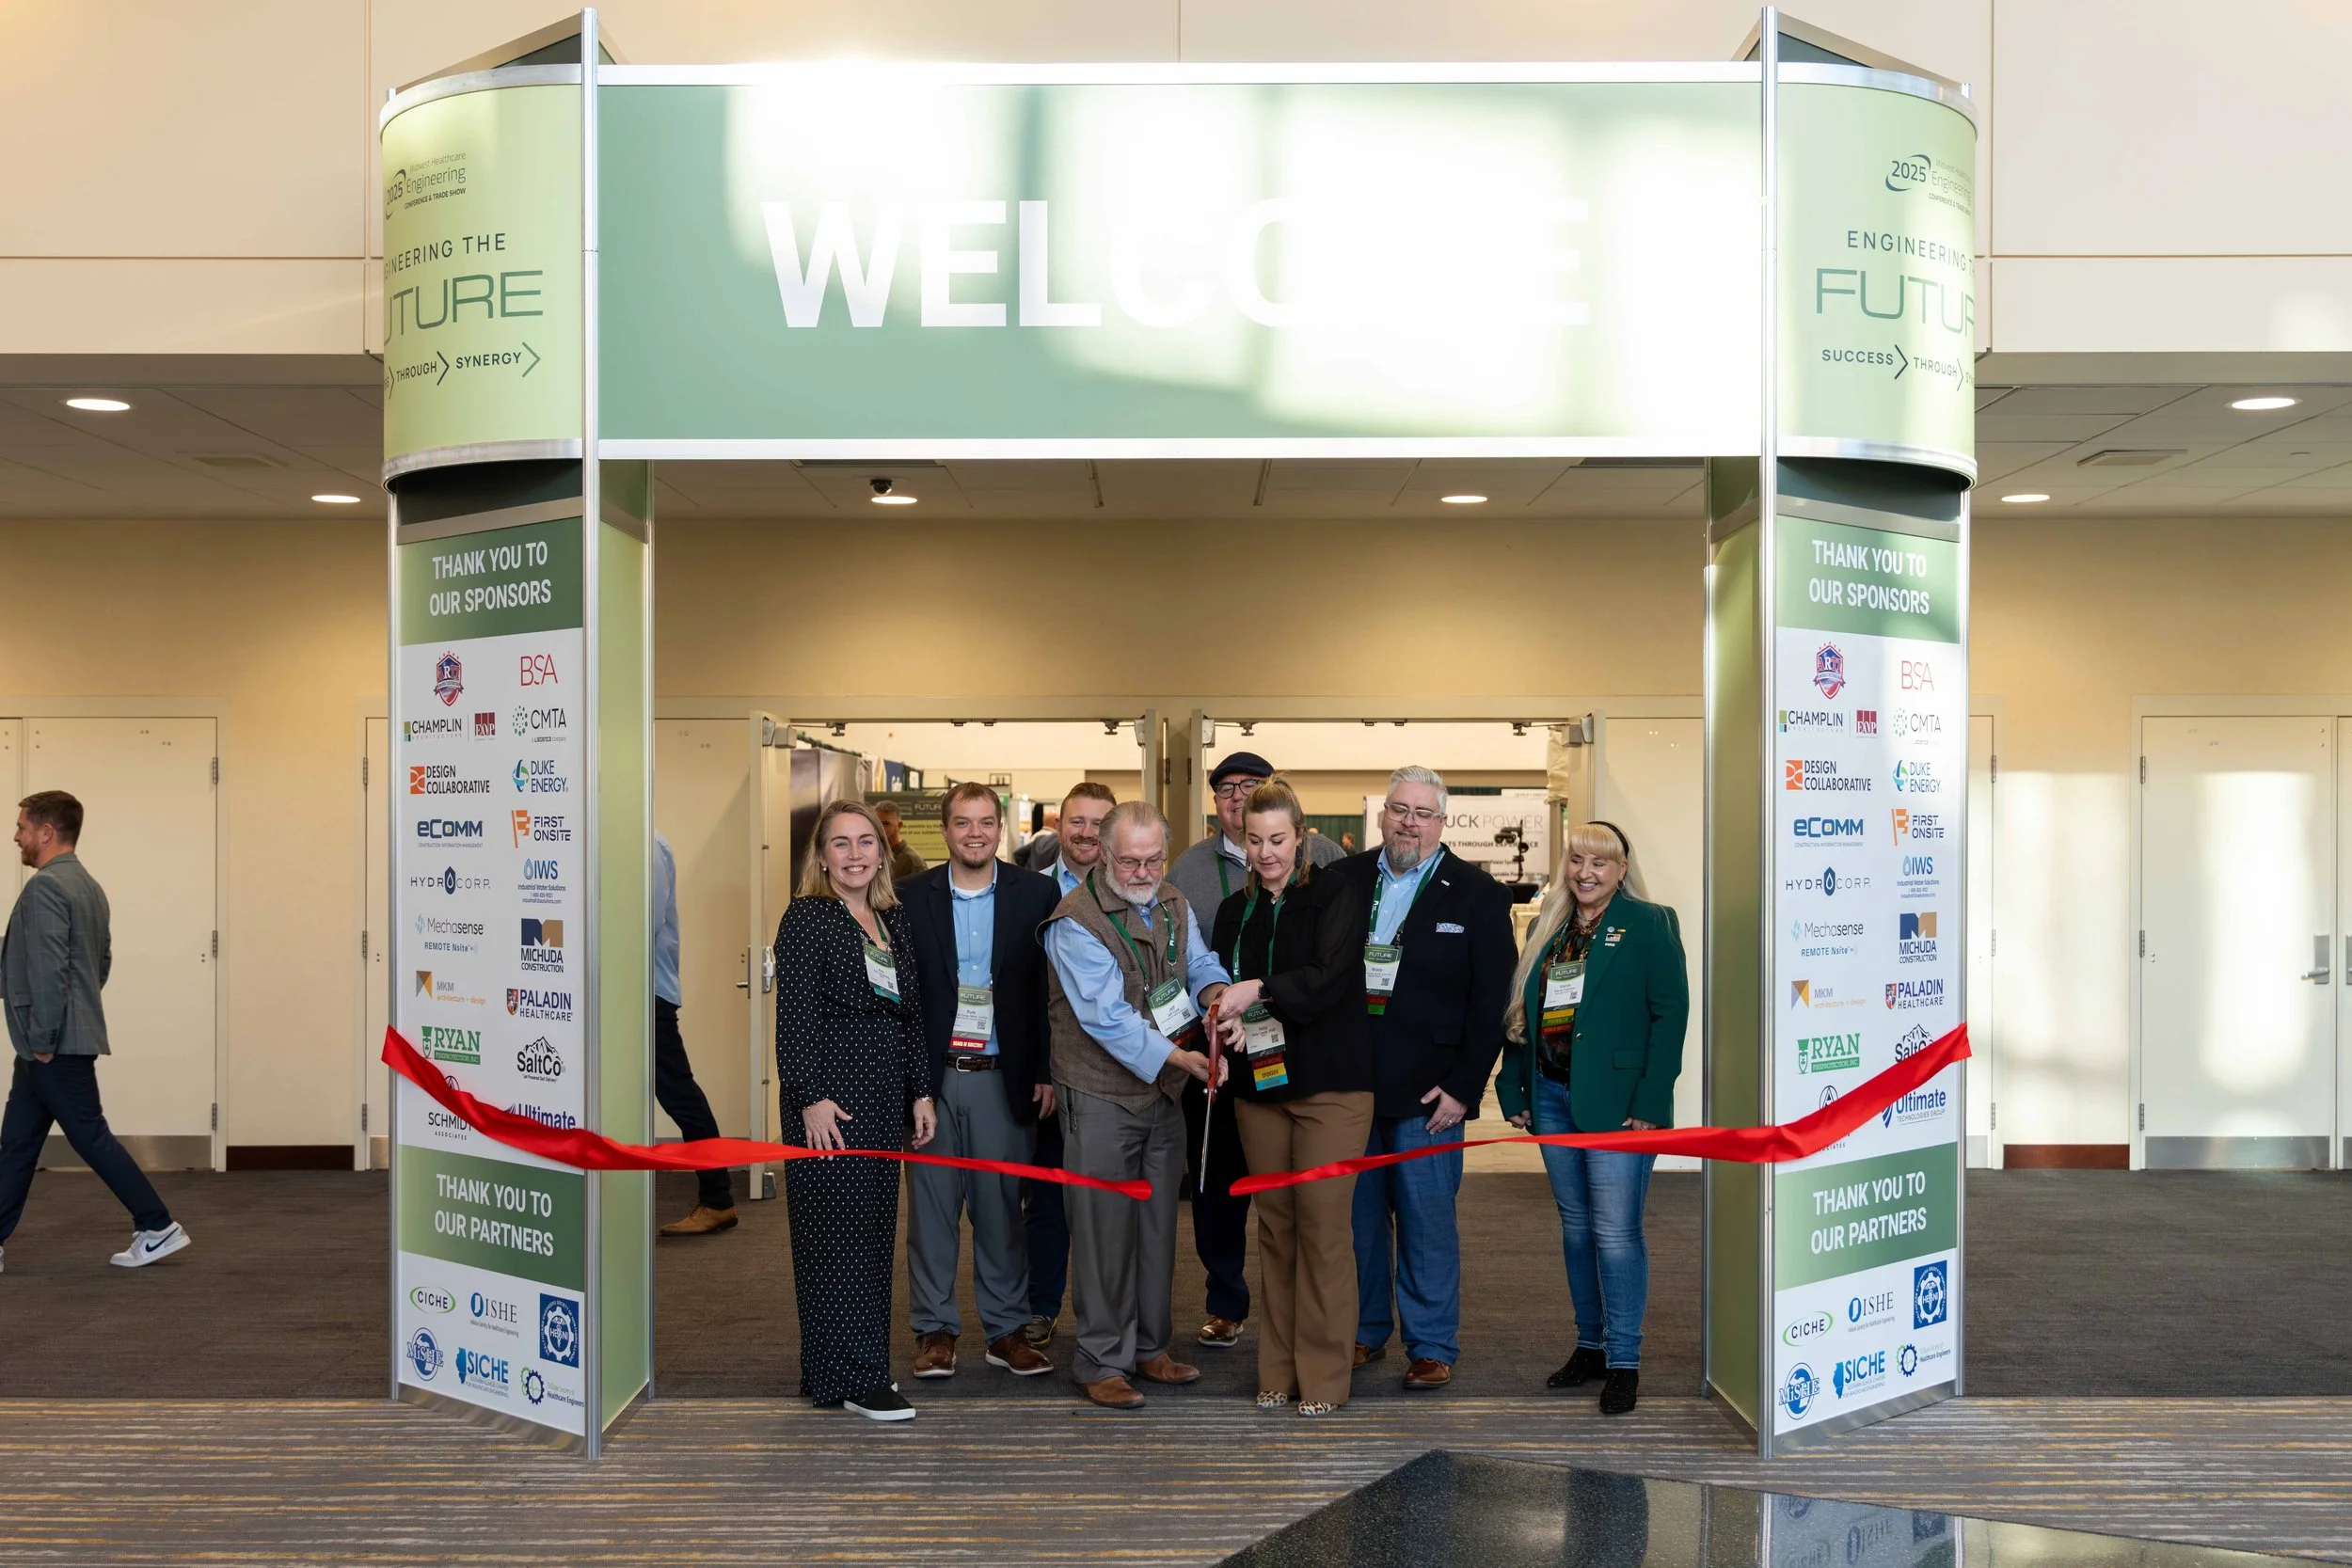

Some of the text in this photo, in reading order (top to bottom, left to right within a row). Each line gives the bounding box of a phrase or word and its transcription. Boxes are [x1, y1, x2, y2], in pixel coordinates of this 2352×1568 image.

[432, 152, 467, 166] Healthcare
[1892, 161, 1926, 182] 2025
[406, 167, 467, 194] Engineering
[388, 182, 403, 205] 2025
[405, 196, 428, 209] CONFERENCE
[433, 190, 448, 199] TRADE
[450, 188, 467, 197] SHOW
[462, 233, 505, 254] THE
[1848, 230, 1966, 271] ENGINEERING
[396, 352, 521, 382] THROUGH SYNERGY
[1822, 349, 1957, 377] SUCCESS THROUGH
[433, 541, 548, 579] THANK YOU TO
[1812, 540, 1927, 578] THANK YOU TO
[429, 579, 551, 617] OUR SPONSORS
[1808, 578, 1930, 615] OUR SPONSORS
[520, 654, 558, 687] BSA
[1900, 660, 1934, 691] BSA
[412, 719, 461, 734] CHAMPLIN
[531, 707, 566, 729] CMTA
[1788, 711, 1843, 726] CHAMPLIN
[1910, 713, 1942, 733] CMTA
[427, 766, 455, 779] DESIGN
[531, 760, 555, 775] DUKE
[1804, 760, 1836, 773] DESIGN
[1910, 762, 1931, 775] DUKE
[427, 780, 489, 794] COLLABORATIVE
[1804, 777, 1870, 791] COLLABORATIVE
[1910, 779, 1942, 792] ENERGY
[534, 816, 564, 828] FIRST
[1483, 815, 1543, 828] POWER
[1912, 816, 1938, 826] FIRST
[534, 830, 571, 841] ONSITE
[1912, 828, 1944, 839] ONSITE
[534, 860, 558, 879] IWS
[1913, 856, 1932, 875] IWS
[427, 918, 484, 935] Mechasense
[1804, 922, 1863, 939] Mechasense
[424, 942, 450, 951] REMOTE
[1801, 947, 1829, 958] REMOTE
[1899, 941, 1936, 955] MICHUDA
[521, 948, 563, 963] MICHUDA
[1899, 954, 1937, 963] CONSTRUCTION
[521, 963, 564, 973] CONSTRUCTION
[1556, 968, 1577, 976] FUTURE
[437, 982, 453, 991] MKM
[1155, 987, 1176, 1002] FUTURE
[1814, 988, 1833, 999] MKM
[1899, 978, 1944, 999] PALADIN
[519, 990, 571, 1010] PALADIN
[1899, 997, 1944, 1009] HEALTHCARE
[519, 1008, 571, 1022] HEALTHCARE
[435, 1027, 481, 1052] RYAN
[1812, 1033, 1860, 1059] RYAN
[517, 1052, 561, 1076] SaltCo
[1262, 1069, 1279, 1078] SPONSOR
[1897, 1089, 1946, 1114] Ultimate
[1897, 1109, 1946, 1122] TECHNOLOGIES GROUP
[435, 1131, 467, 1140] ASSOCIATES
[437, 1174, 551, 1217] THANK YOU TO
[1813, 1171, 1925, 1215] THANK YOU TO
[435, 1210, 553, 1257] OUR PARTNERS
[1811, 1207, 1927, 1255] OUR PARTNERS
[418, 1291, 448, 1309] CICHE
[1863, 1291, 1893, 1317] ISHE
[485, 1298, 517, 1323] ISHE
[1791, 1319, 1825, 1339] CICHE
[1920, 1349, 1951, 1363] Healthcare Engineers
[468, 1351, 508, 1384] SICHE
[1845, 1351, 1885, 1383] SICHE
[548, 1391, 584, 1407] Healthcare Engineers
